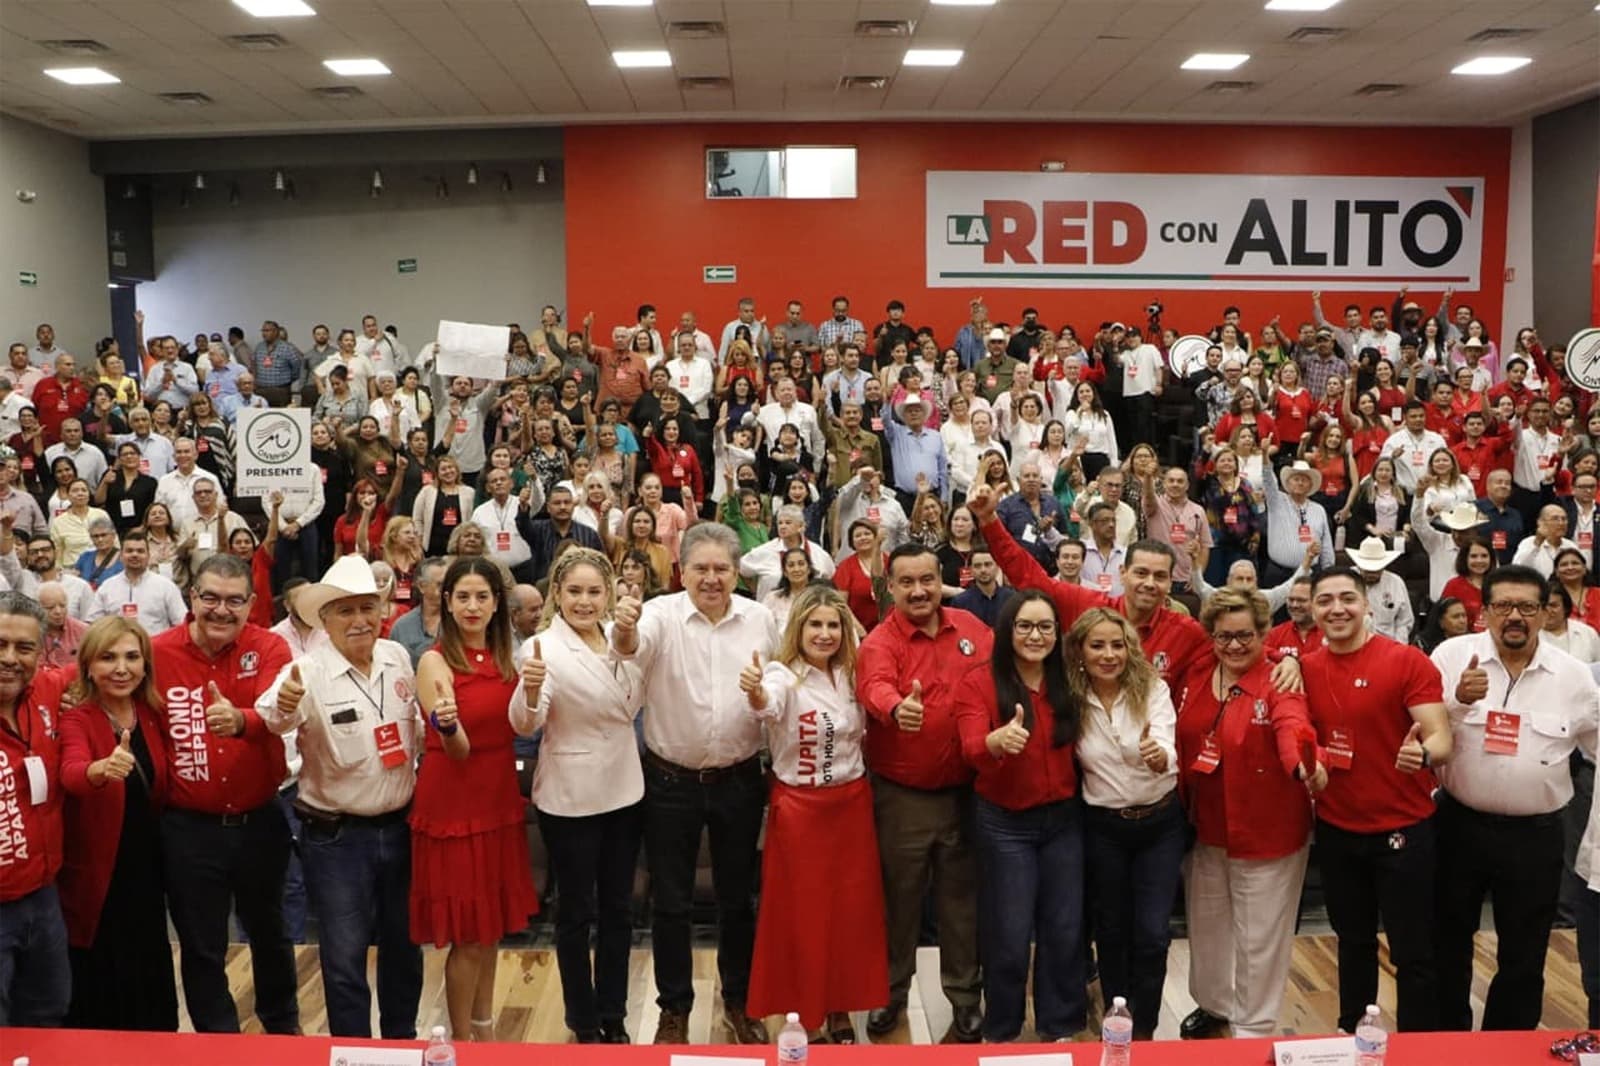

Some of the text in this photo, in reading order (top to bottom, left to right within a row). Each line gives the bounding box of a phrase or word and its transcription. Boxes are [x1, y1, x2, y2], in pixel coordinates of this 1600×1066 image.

[947, 198, 1463, 268] LA RED CON ALITO
[246, 467, 303, 477] PRESENTE
[166, 686, 195, 782] ANTONIO
[190, 685, 209, 782] ZEPEDA
[798, 710, 817, 787] LUPITA
[0, 750, 29, 859] APARICIO
[823, 762, 832, 784] OTO
